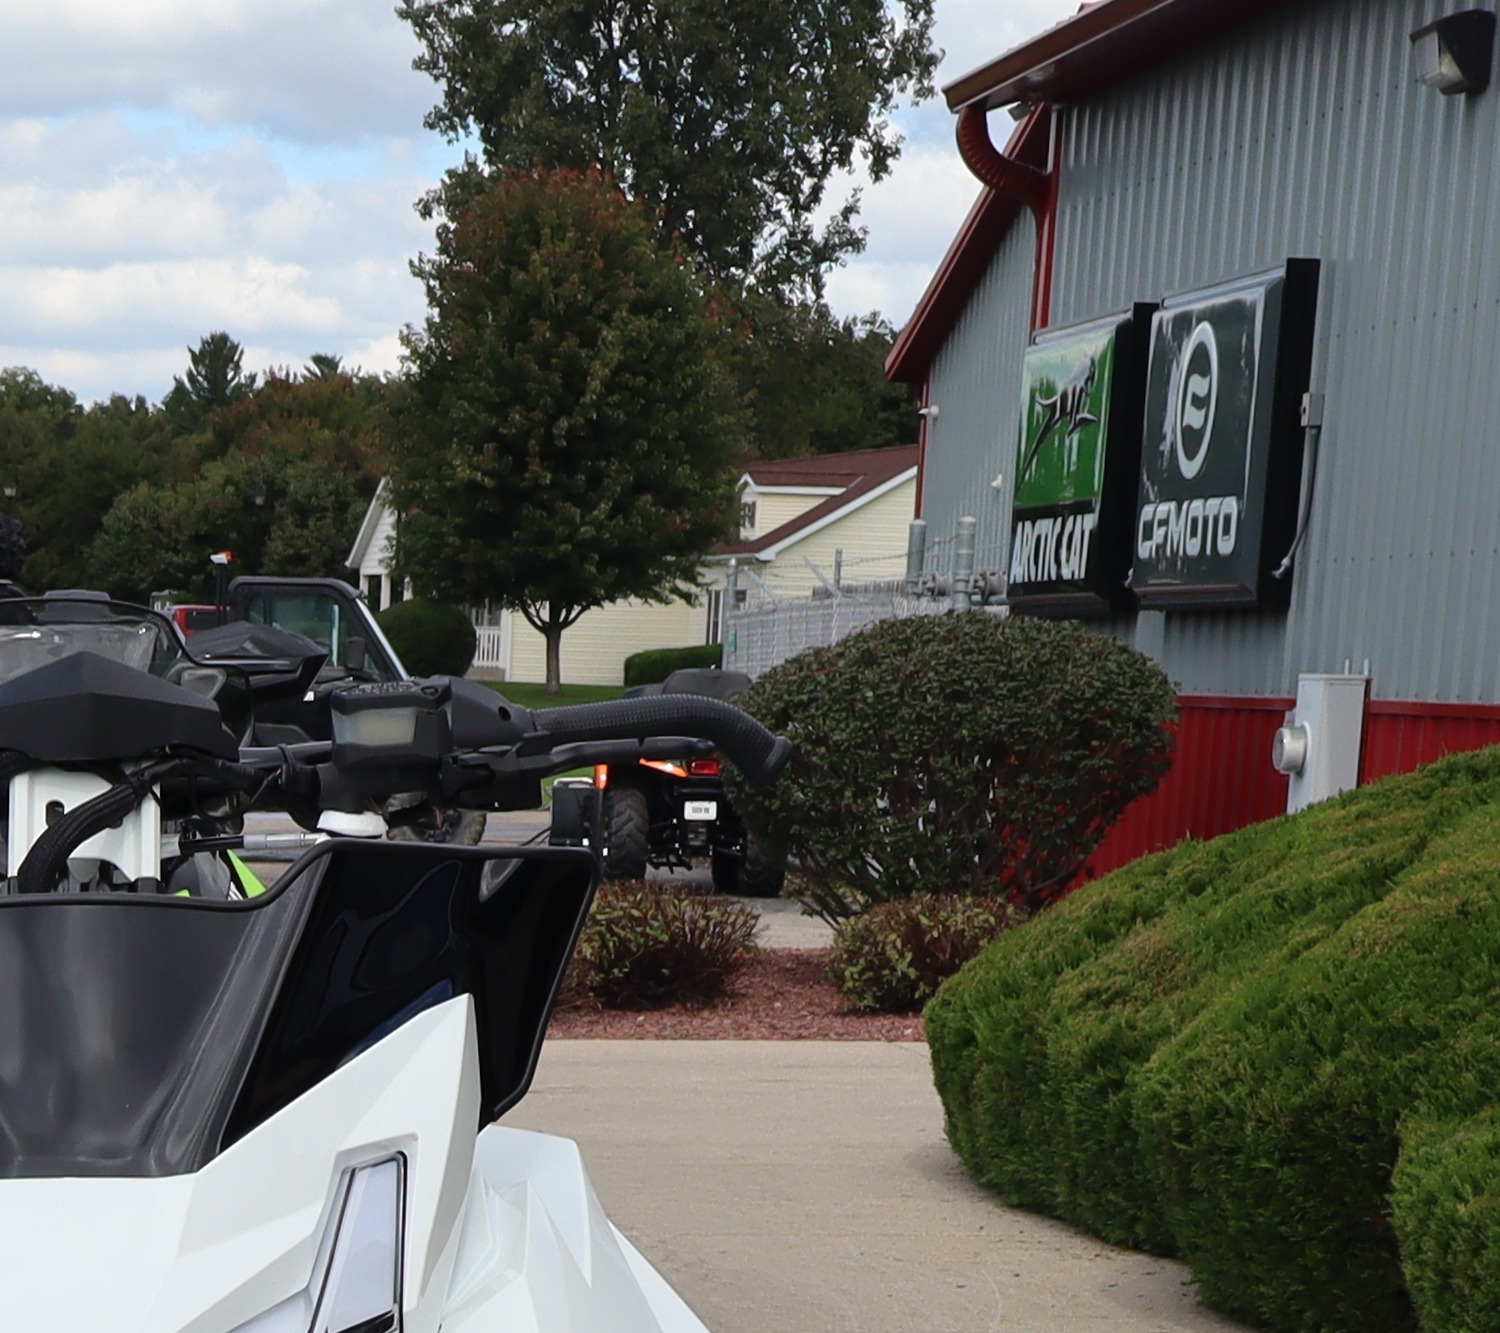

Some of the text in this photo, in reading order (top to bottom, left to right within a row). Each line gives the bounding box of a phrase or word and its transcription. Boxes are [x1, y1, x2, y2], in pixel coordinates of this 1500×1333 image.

[1009, 513, 1096, 584] ARCTIC CAT
[1137, 495, 1238, 560] CFMOTO
